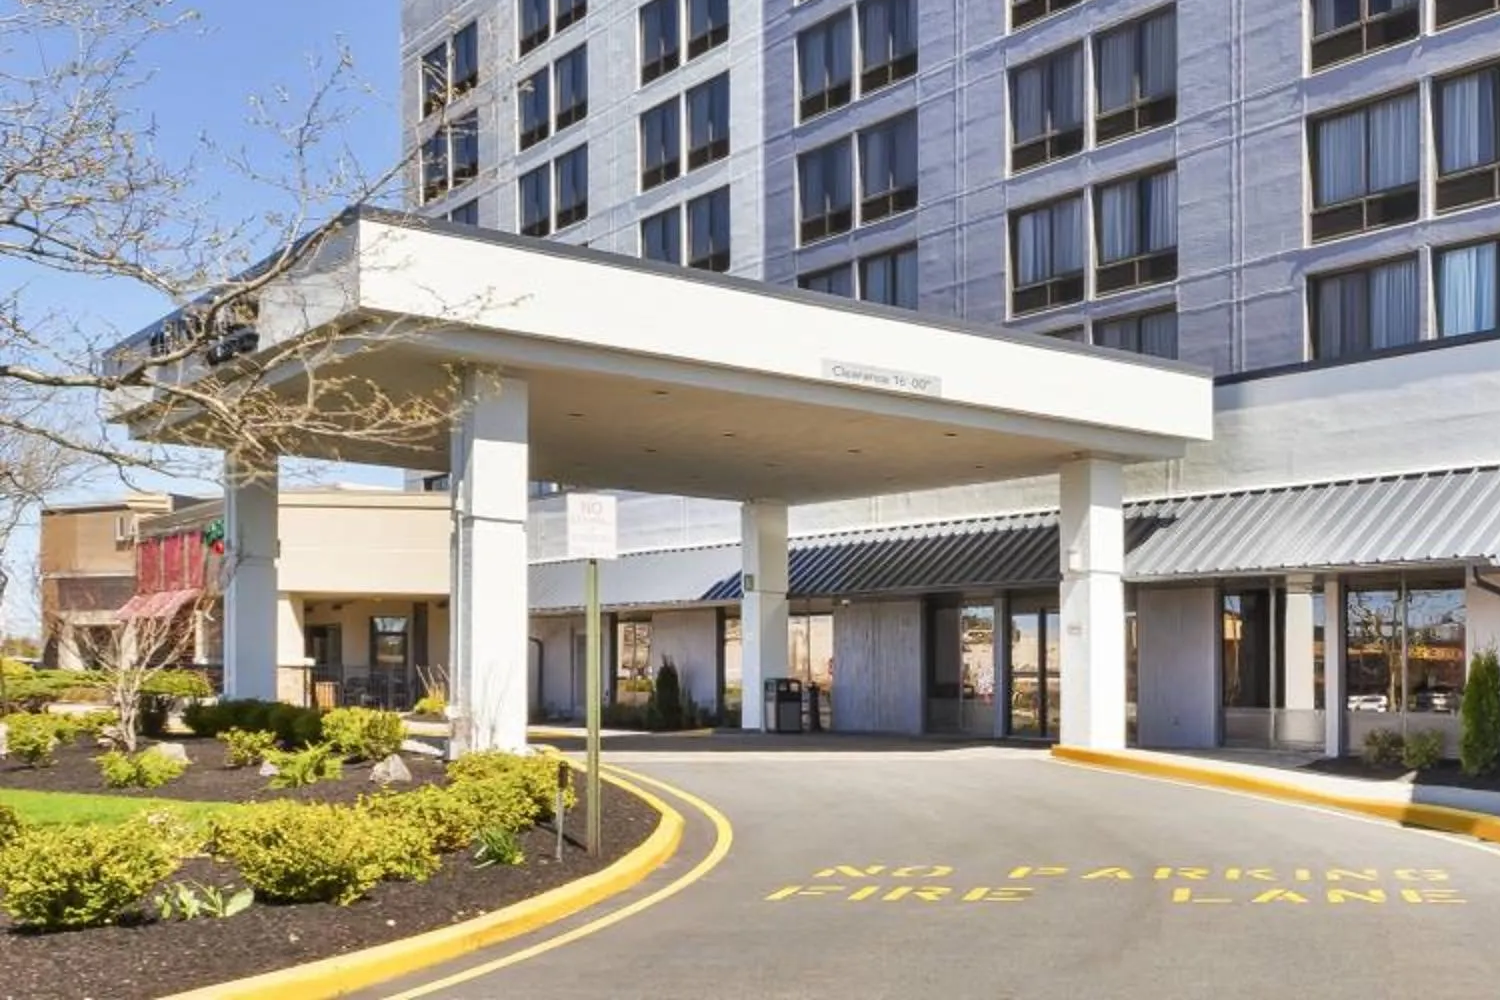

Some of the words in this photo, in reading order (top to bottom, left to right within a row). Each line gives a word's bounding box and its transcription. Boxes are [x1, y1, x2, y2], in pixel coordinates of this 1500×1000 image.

[813, 865, 954, 878] NO
[1007, 866, 1449, 881] PARKING
[764, 885, 1034, 901] FIRE
[1172, 887, 1467, 903] LANE
